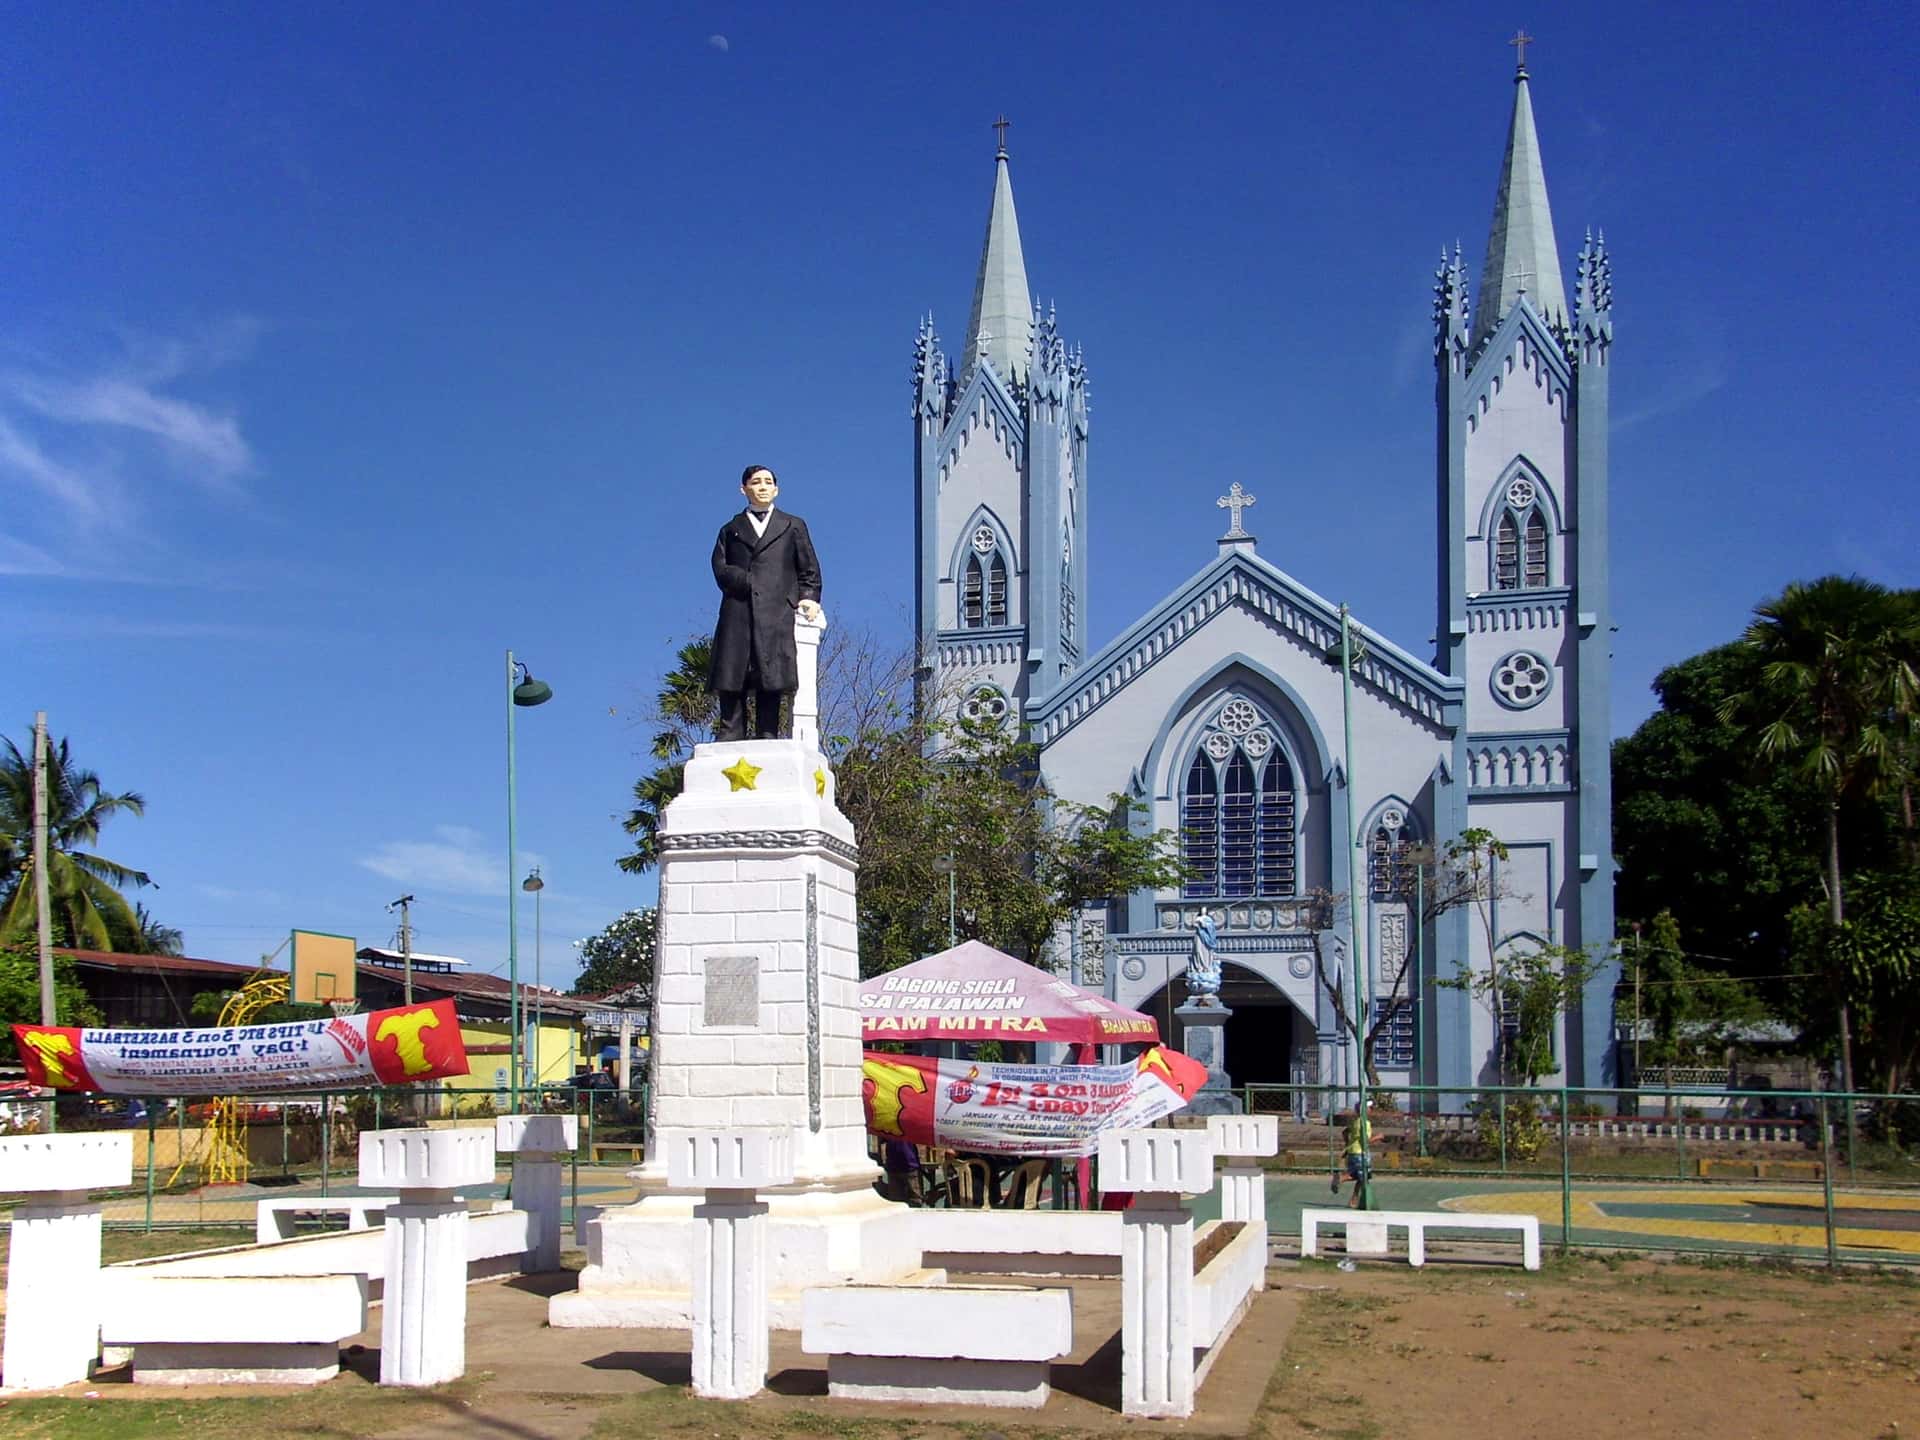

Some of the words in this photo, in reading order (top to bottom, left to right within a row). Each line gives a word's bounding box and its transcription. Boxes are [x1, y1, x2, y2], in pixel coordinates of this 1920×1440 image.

[883, 976, 961, 994] BAGONG
[962, 978, 1017, 994] SIGLA
[860, 993, 895, 1009] SA
[897, 996, 1027, 1011] PALAWAN
[938, 1016, 1048, 1032] MITRA
[992, 1066, 1038, 1074] TECHNIQUES
[980, 1082, 1023, 1107] 1st
[1029, 1083, 1049, 1097] 3
[1054, 1084, 1087, 1098] on
